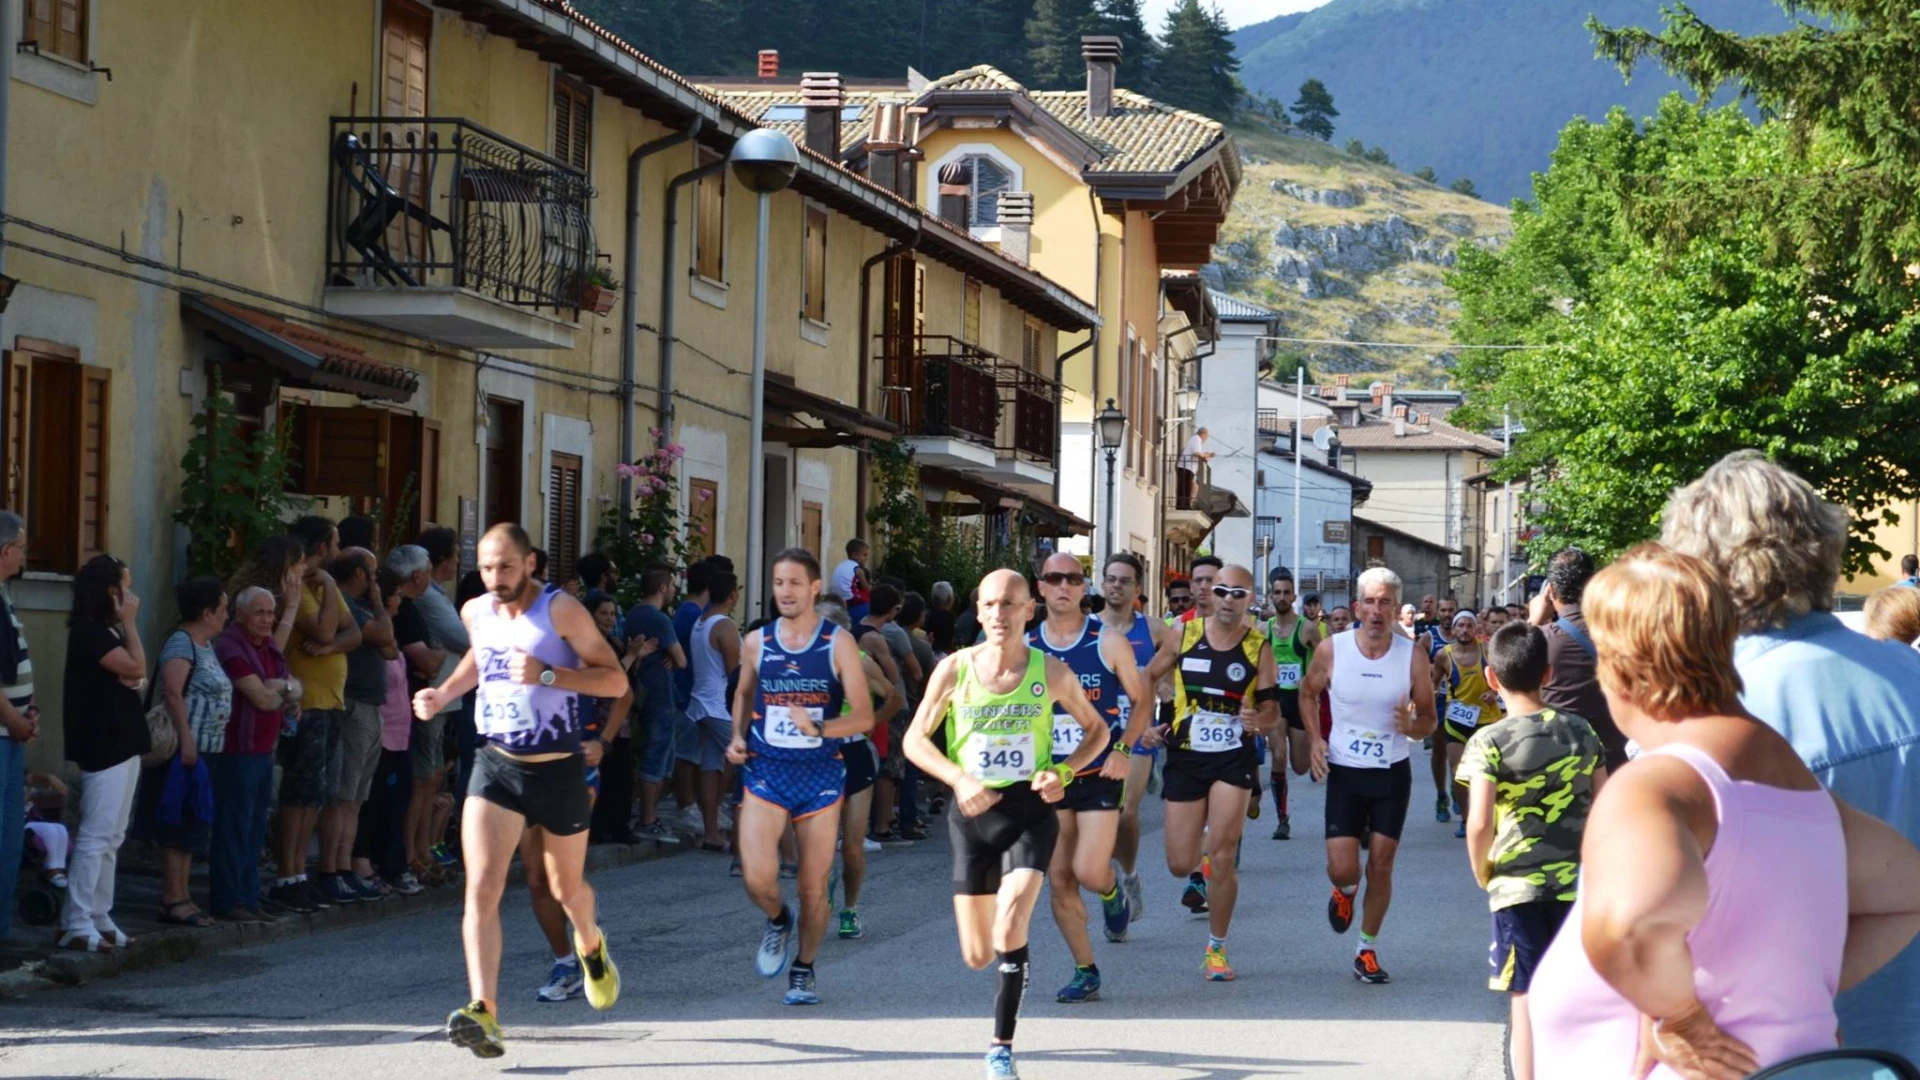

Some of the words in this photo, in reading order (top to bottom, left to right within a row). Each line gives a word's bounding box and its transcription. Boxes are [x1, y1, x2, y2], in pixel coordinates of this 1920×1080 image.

[761, 679, 829, 692] RUNNERS
[483, 702, 520, 720] 403
[960, 703, 1043, 720] RUNNERS
[1452, 706, 1473, 720] 230
[1200, 727, 1234, 742] 369
[1350, 740, 1384, 757] 473
[978, 750, 1024, 768] 349
